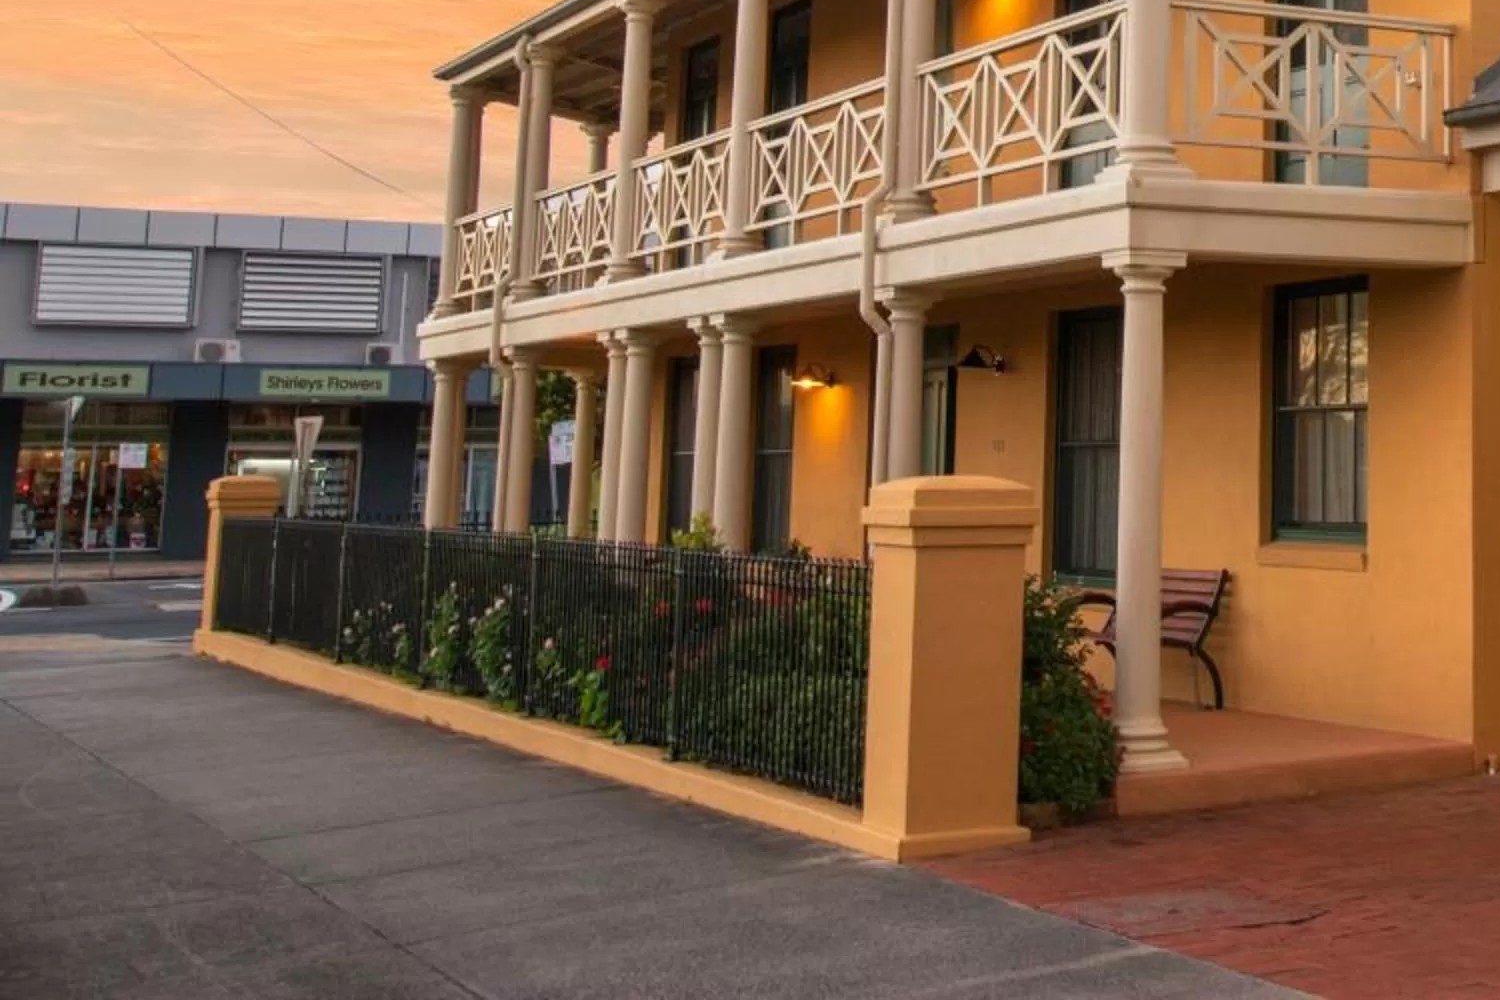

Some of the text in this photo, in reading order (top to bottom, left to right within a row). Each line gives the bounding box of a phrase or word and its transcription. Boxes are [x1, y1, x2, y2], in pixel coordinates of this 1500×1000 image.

[19, 370, 132, 388] Florist
[266, 375, 383, 392] Shirleys Flowers
